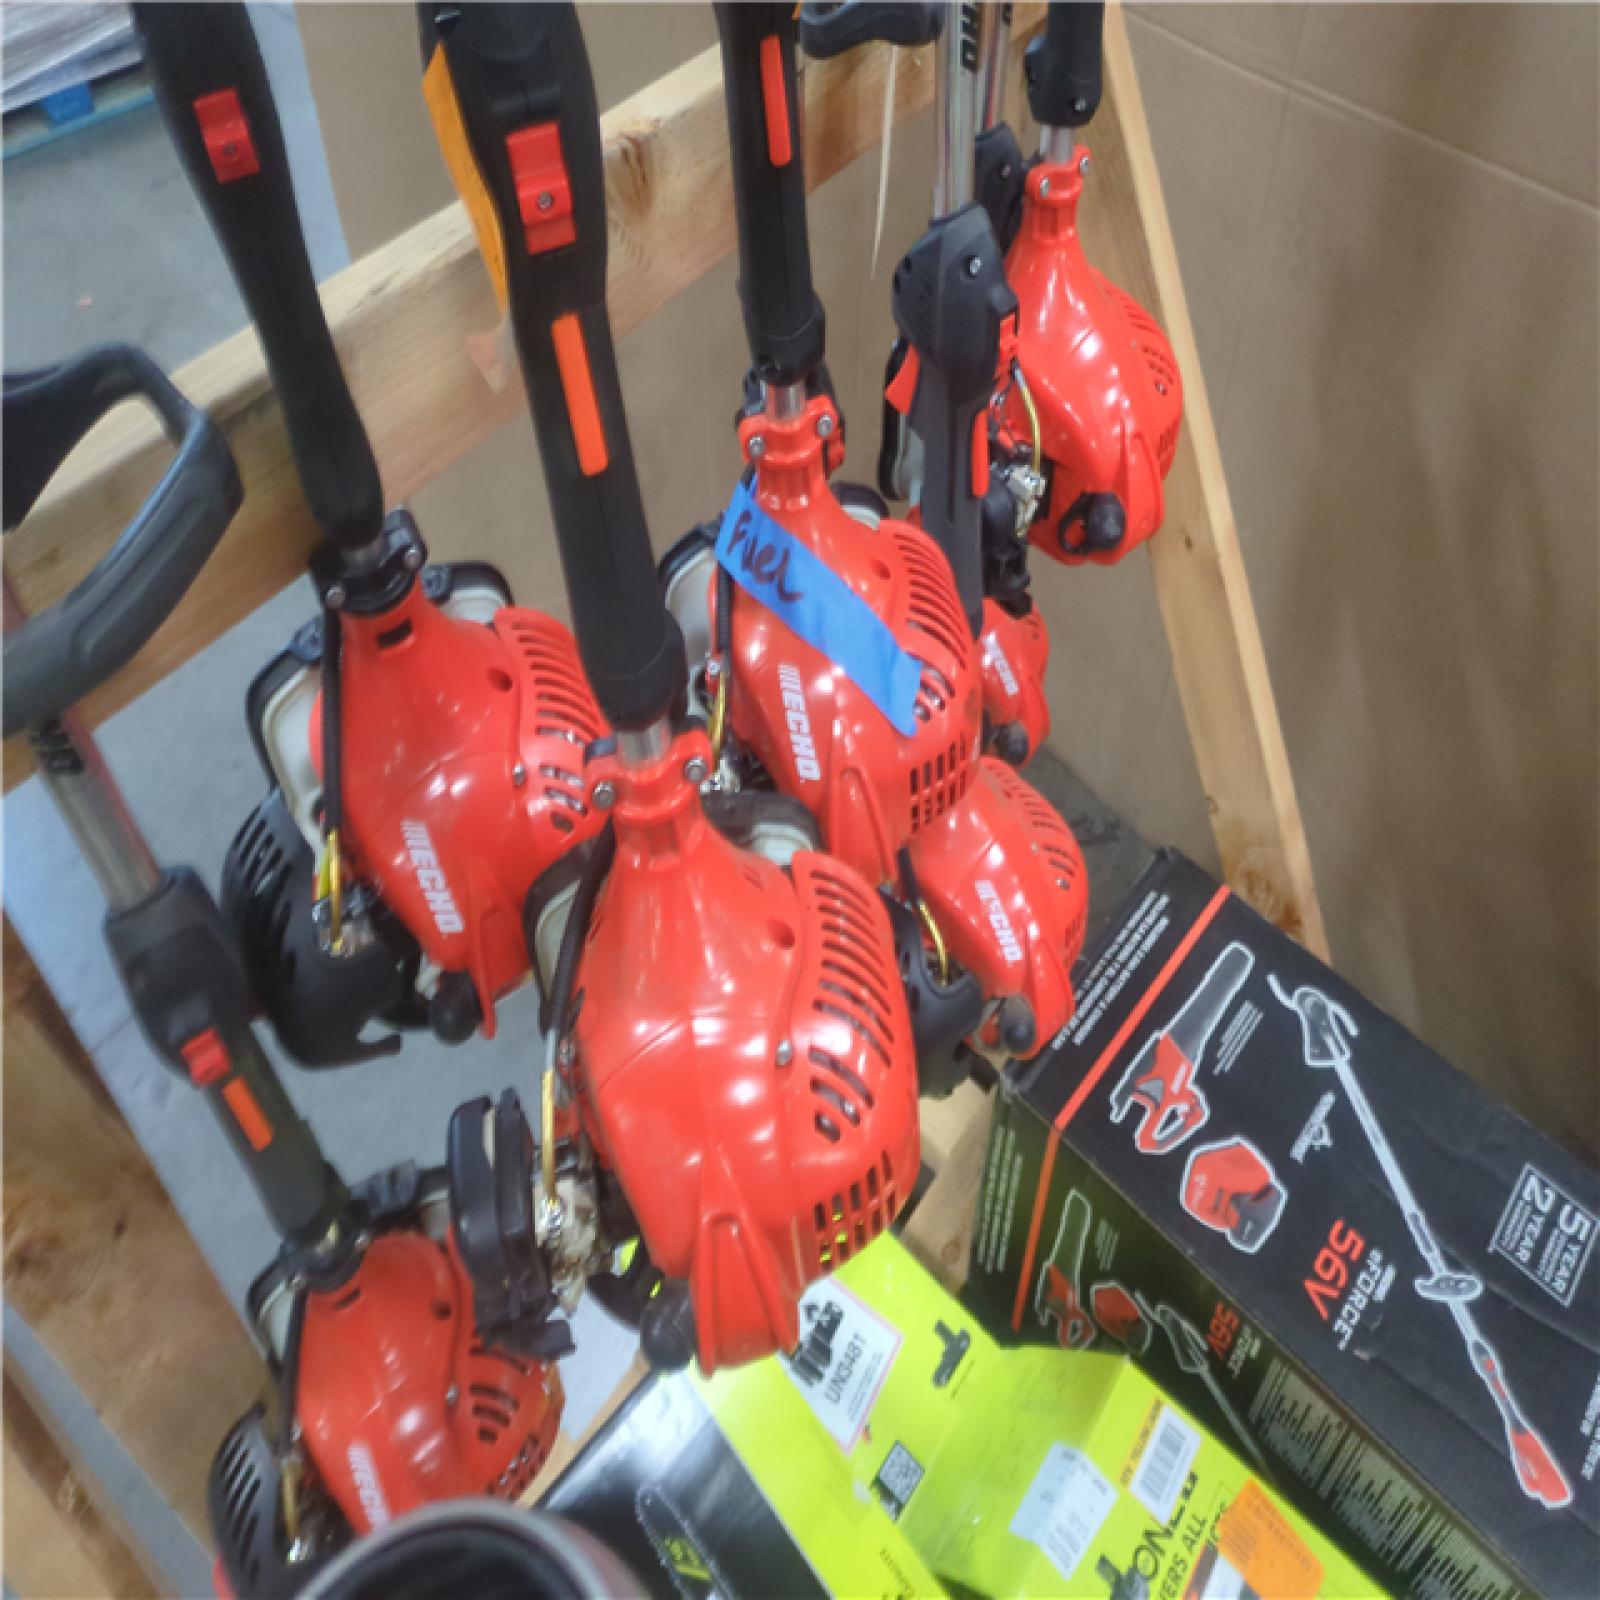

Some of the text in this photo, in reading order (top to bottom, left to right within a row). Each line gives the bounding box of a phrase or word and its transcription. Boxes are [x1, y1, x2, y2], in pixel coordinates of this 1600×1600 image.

[782, 689, 822, 782] ECHO
[409, 848, 466, 934] ECHO
[1522, 1173, 1557, 1214] 2
[1559, 1203, 1592, 1243] 5
[1303, 1218, 1366, 1321] 56V
